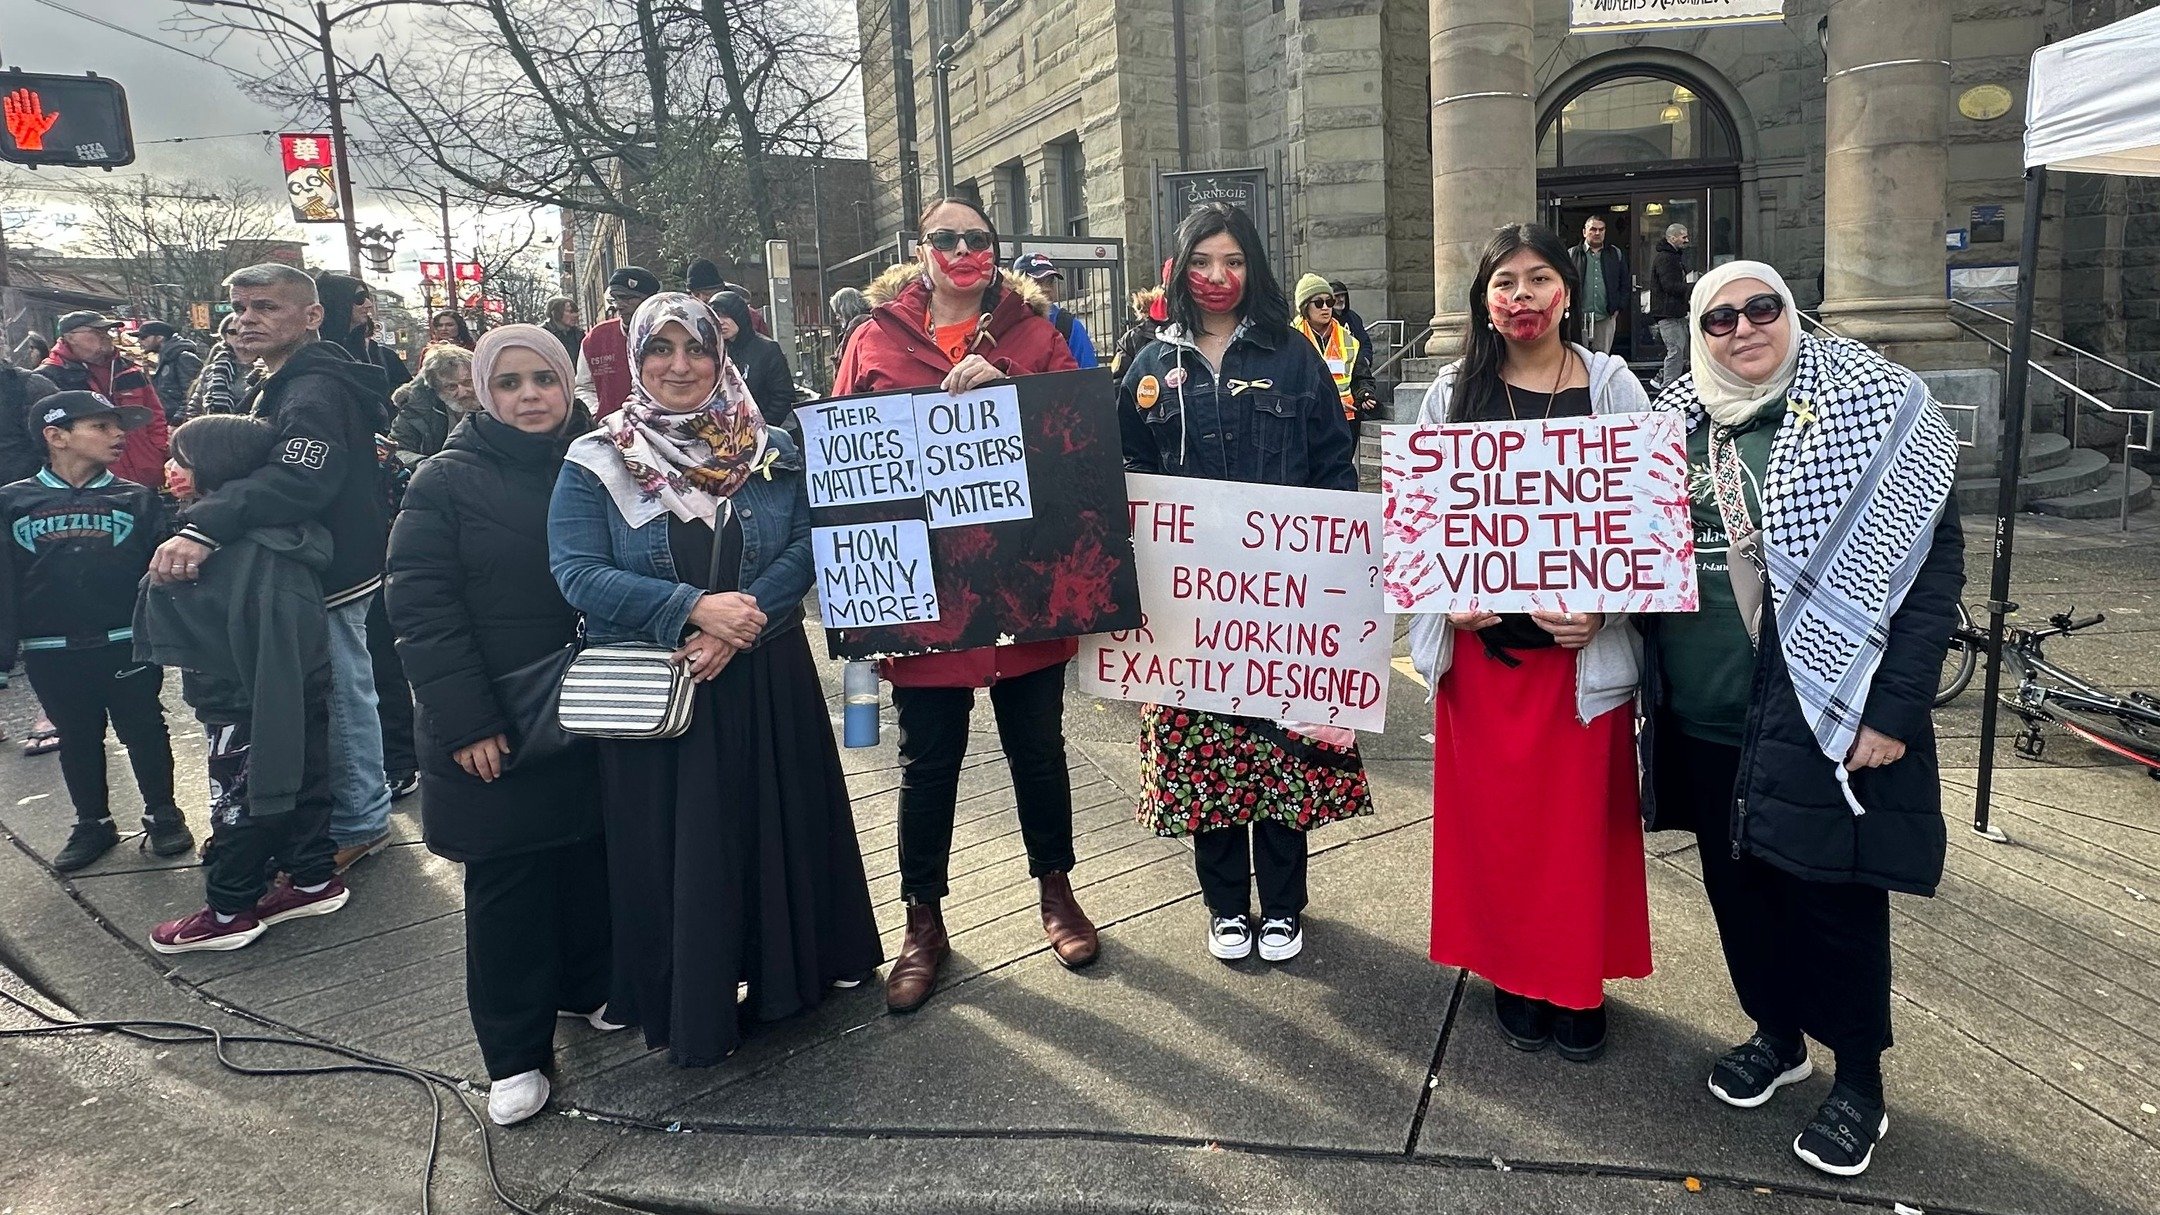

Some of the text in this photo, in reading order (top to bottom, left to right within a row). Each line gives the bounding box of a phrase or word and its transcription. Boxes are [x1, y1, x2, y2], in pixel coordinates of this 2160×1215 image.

[1187, 189, 1247, 202] CARNEGIE
[816, 405, 882, 431] THEIR
[928, 400, 1000, 435] OUR
[281, 437, 330, 470] 93
[819, 429, 904, 465] VOICES
[925, 435, 1024, 476] SISTERS
[1408, 425, 1640, 473] STOP THE
[811, 459, 917, 504] MATTER!
[925, 480, 1025, 521] MATTER
[1449, 466, 1634, 510] SILENCE
[12, 509, 135, 554] GRIZZLIES
[832, 525, 898, 564] HOW
[1128, 500, 1372, 555] THE SYSTEM
[1444, 509, 1634, 547] END THE
[824, 559, 918, 597] MANY
[1172, 566, 1307, 609] BROKEN
[1368, 566, 1379, 587] ?
[1436, 547, 1666, 594] VIOLENCE
[828, 593, 935, 627] MORE?
[1195, 617, 1341, 657] WORKING
[1359, 620, 1377, 643] ?
[1098, 648, 1381, 709] EXACTLY DESIGNED
[1120, 684, 1340, 724] ? ? ? ? ?
[1808, 1121, 1854, 1153] adidas
